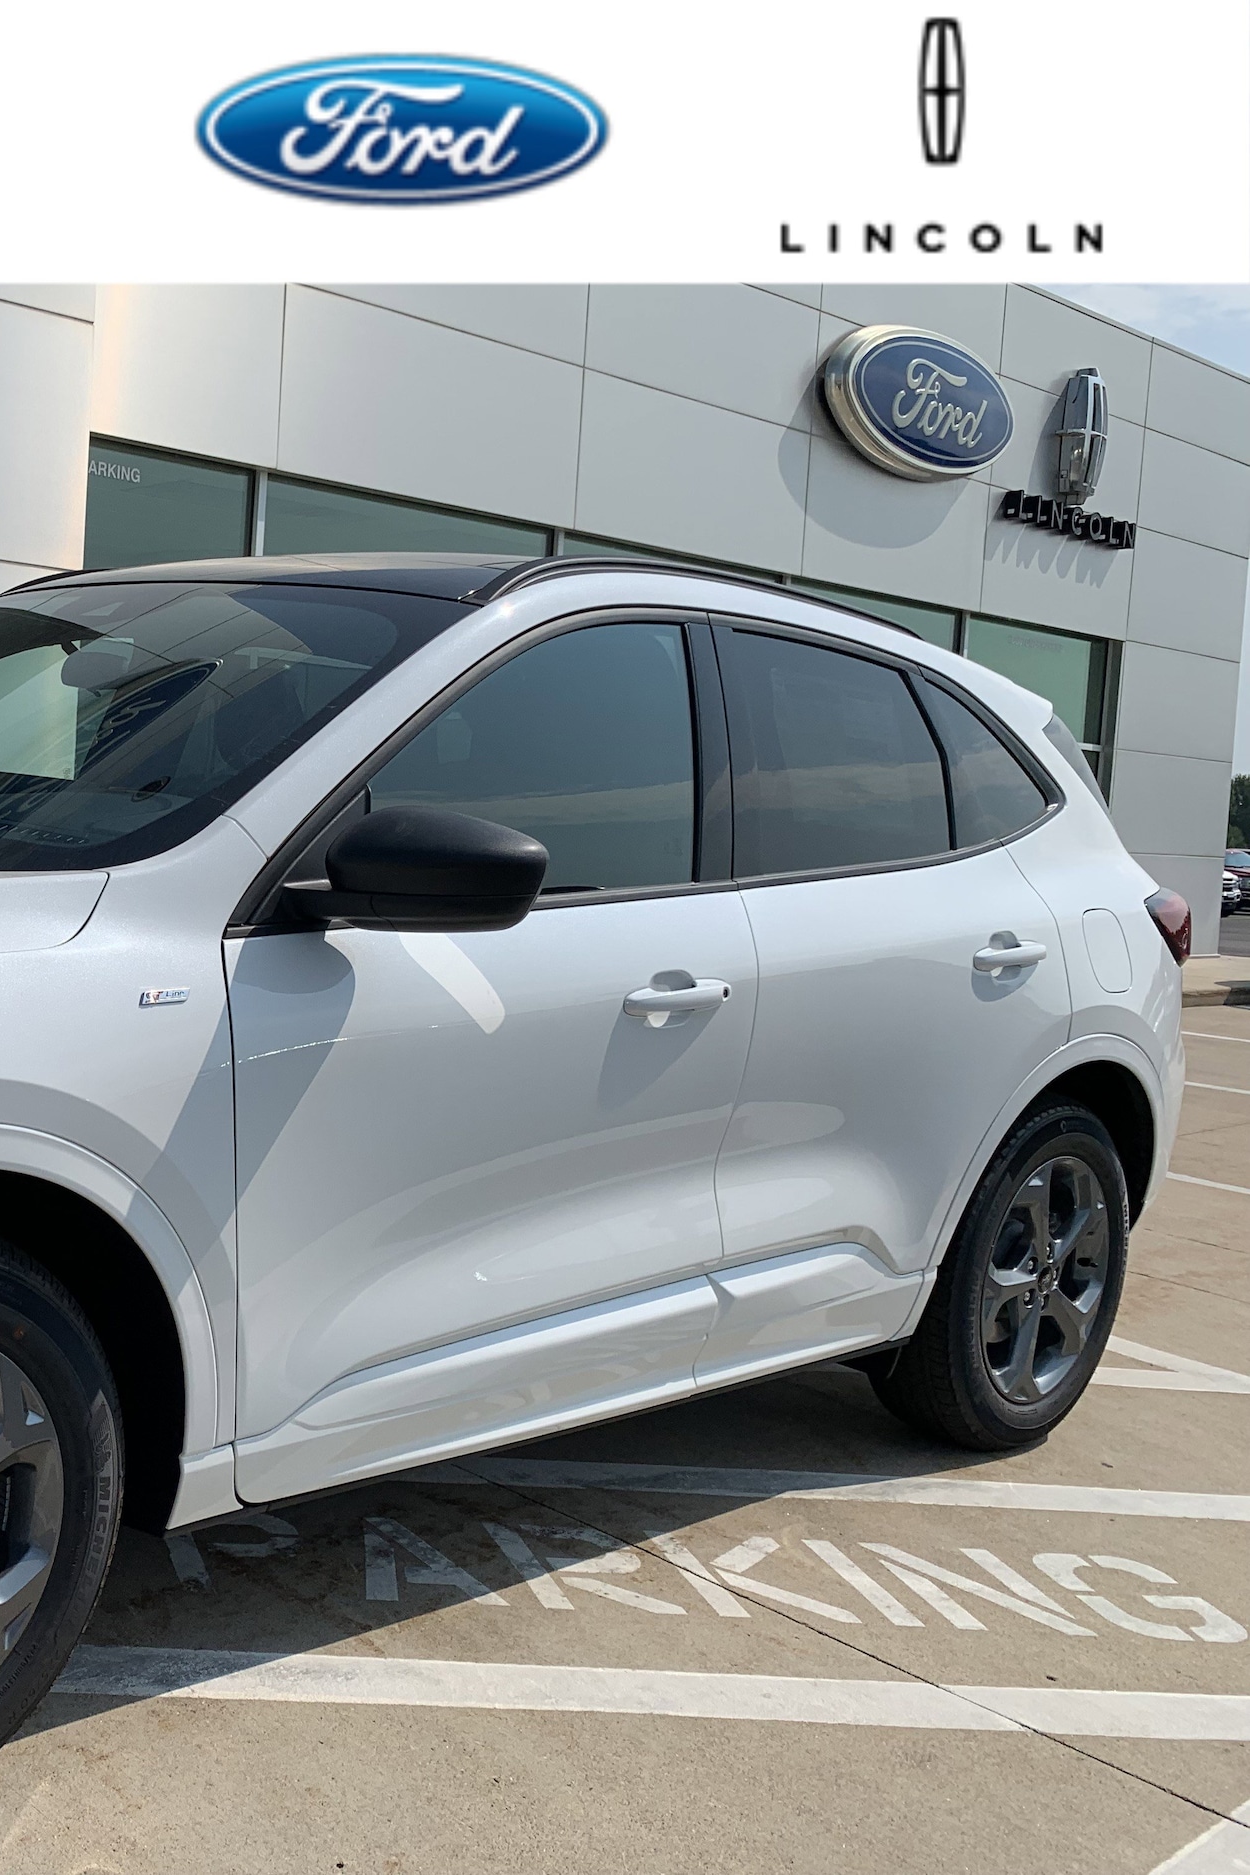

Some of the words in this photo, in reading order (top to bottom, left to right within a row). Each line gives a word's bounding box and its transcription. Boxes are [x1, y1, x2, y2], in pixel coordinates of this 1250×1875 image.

[892, 357, 988, 449] Ford
[1002, 489, 1137, 550] LINCOLN
[164, 1514, 1249, 1645] PARKING
